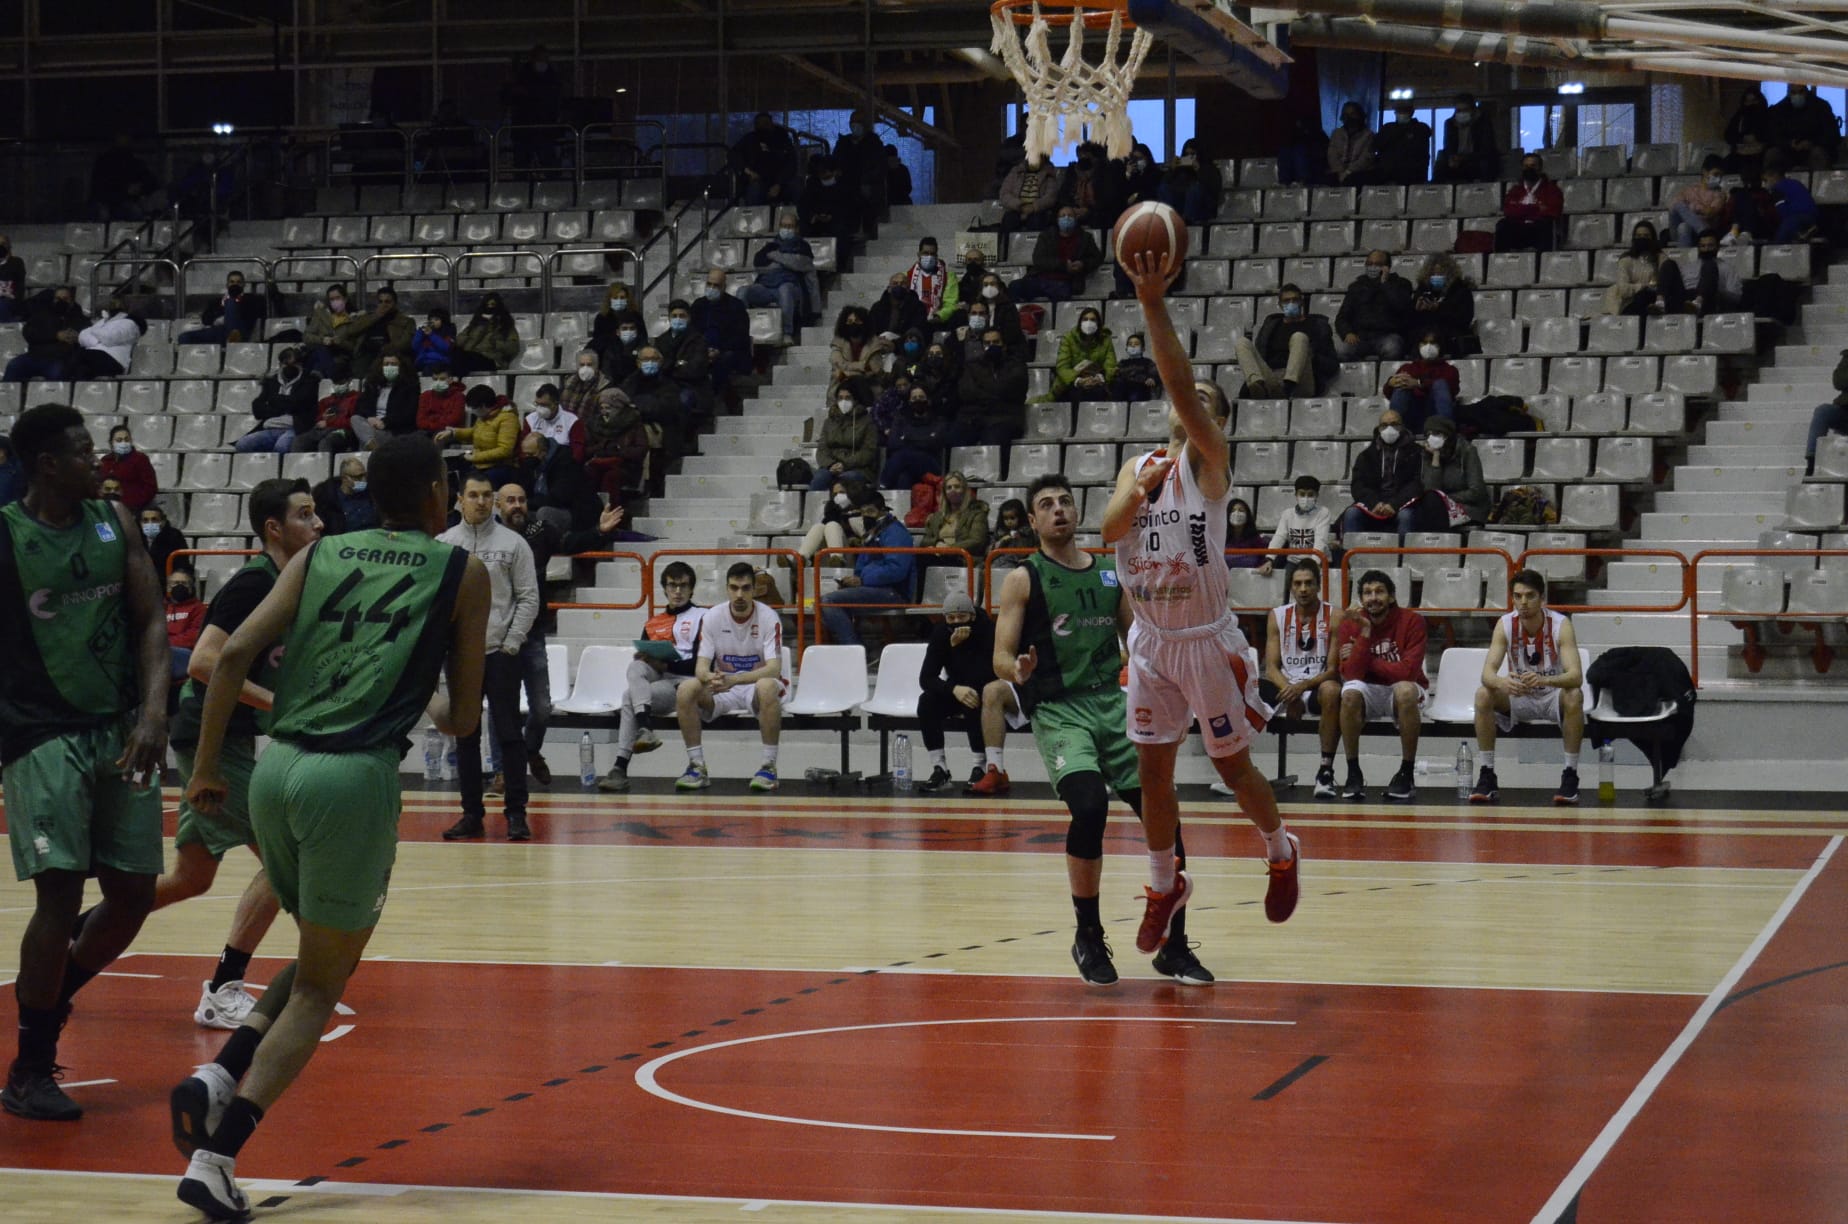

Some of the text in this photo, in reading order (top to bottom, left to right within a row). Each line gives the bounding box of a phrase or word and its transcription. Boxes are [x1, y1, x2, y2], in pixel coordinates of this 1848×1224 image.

[70, 552, 88, 579] 0
[338, 546, 428, 567] GERARD
[319, 567, 416, 642] 44
[1076, 587, 1098, 611] 11
[1303, 667, 1310, 675] 4
